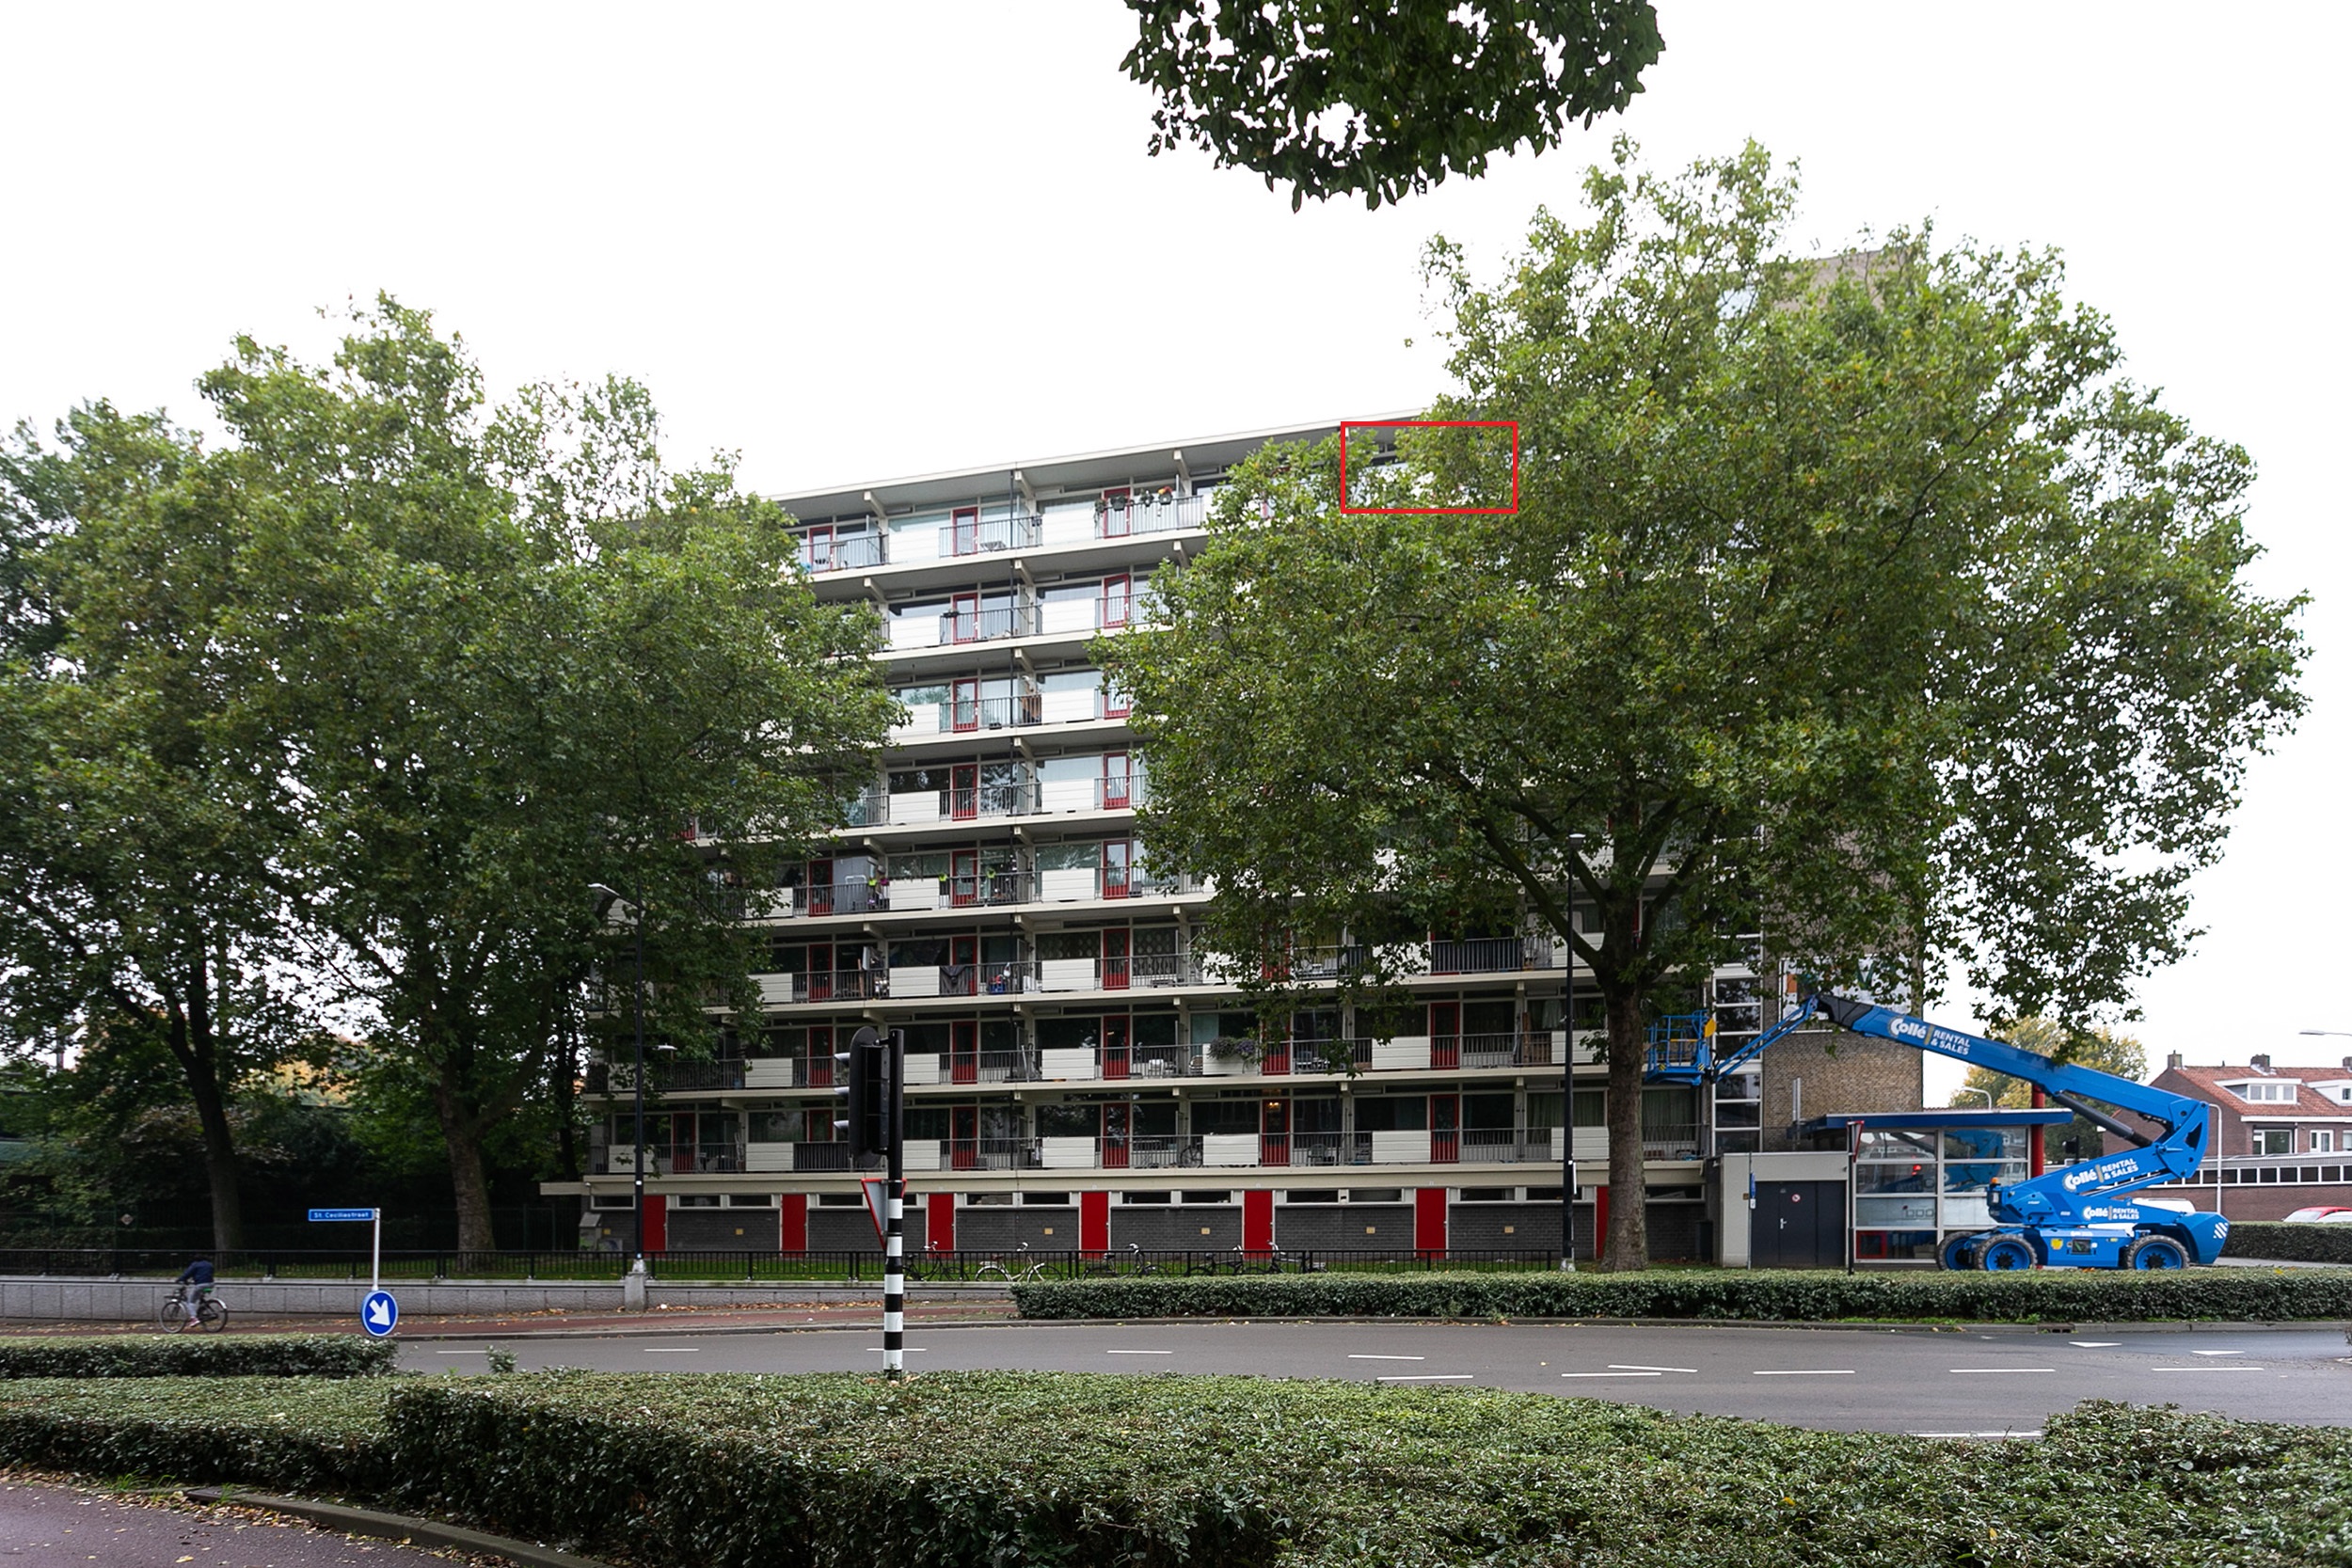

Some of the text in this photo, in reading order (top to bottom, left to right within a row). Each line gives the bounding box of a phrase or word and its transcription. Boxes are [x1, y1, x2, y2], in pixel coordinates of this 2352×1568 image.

[1890, 1018, 1927, 1039] Collé
[1933, 1030, 1971, 1048] RENTAL
[1939, 1040, 1969, 1055] SALES
[2102, 1158, 2137, 1173] RENTAL
[2111, 1164, 2139, 1178] SALES
[2064, 1168, 2098, 1191] Collé
[2083, 1206, 2108, 1220] Collé
